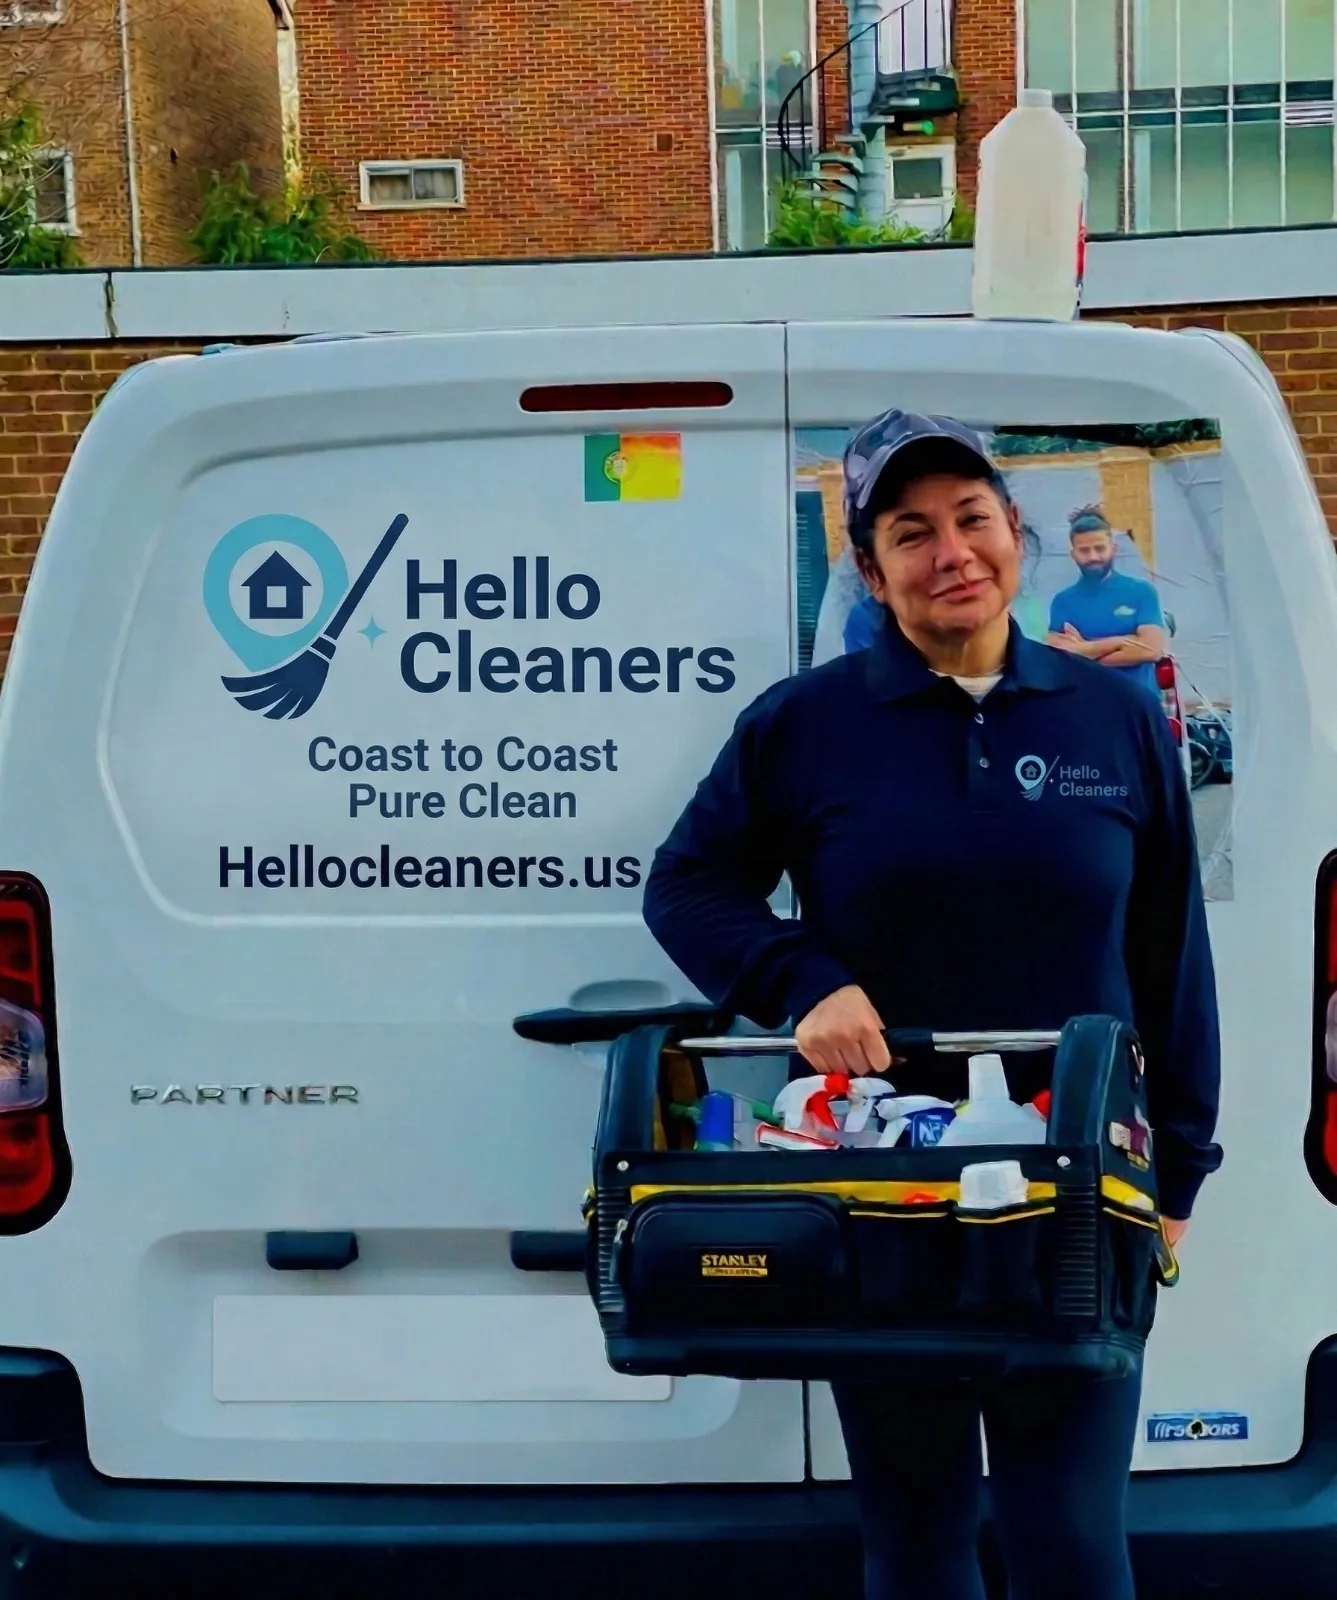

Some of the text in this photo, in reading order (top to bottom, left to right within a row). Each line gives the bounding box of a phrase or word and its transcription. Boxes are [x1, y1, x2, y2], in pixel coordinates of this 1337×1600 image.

[406, 555, 601, 620] Hello
[400, 629, 736, 694] Cleaners
[308, 735, 618, 772] Coast to Coast
[1059, 765, 1100, 780] Hello
[1059, 781, 1128, 797] Cleaners
[349, 781, 577, 819] Pure Clean
[219, 843, 642, 889] Hellocleaners.us
[130, 1083, 359, 1106] PARTNER
[701, 1254, 767, 1267] STANLEY
